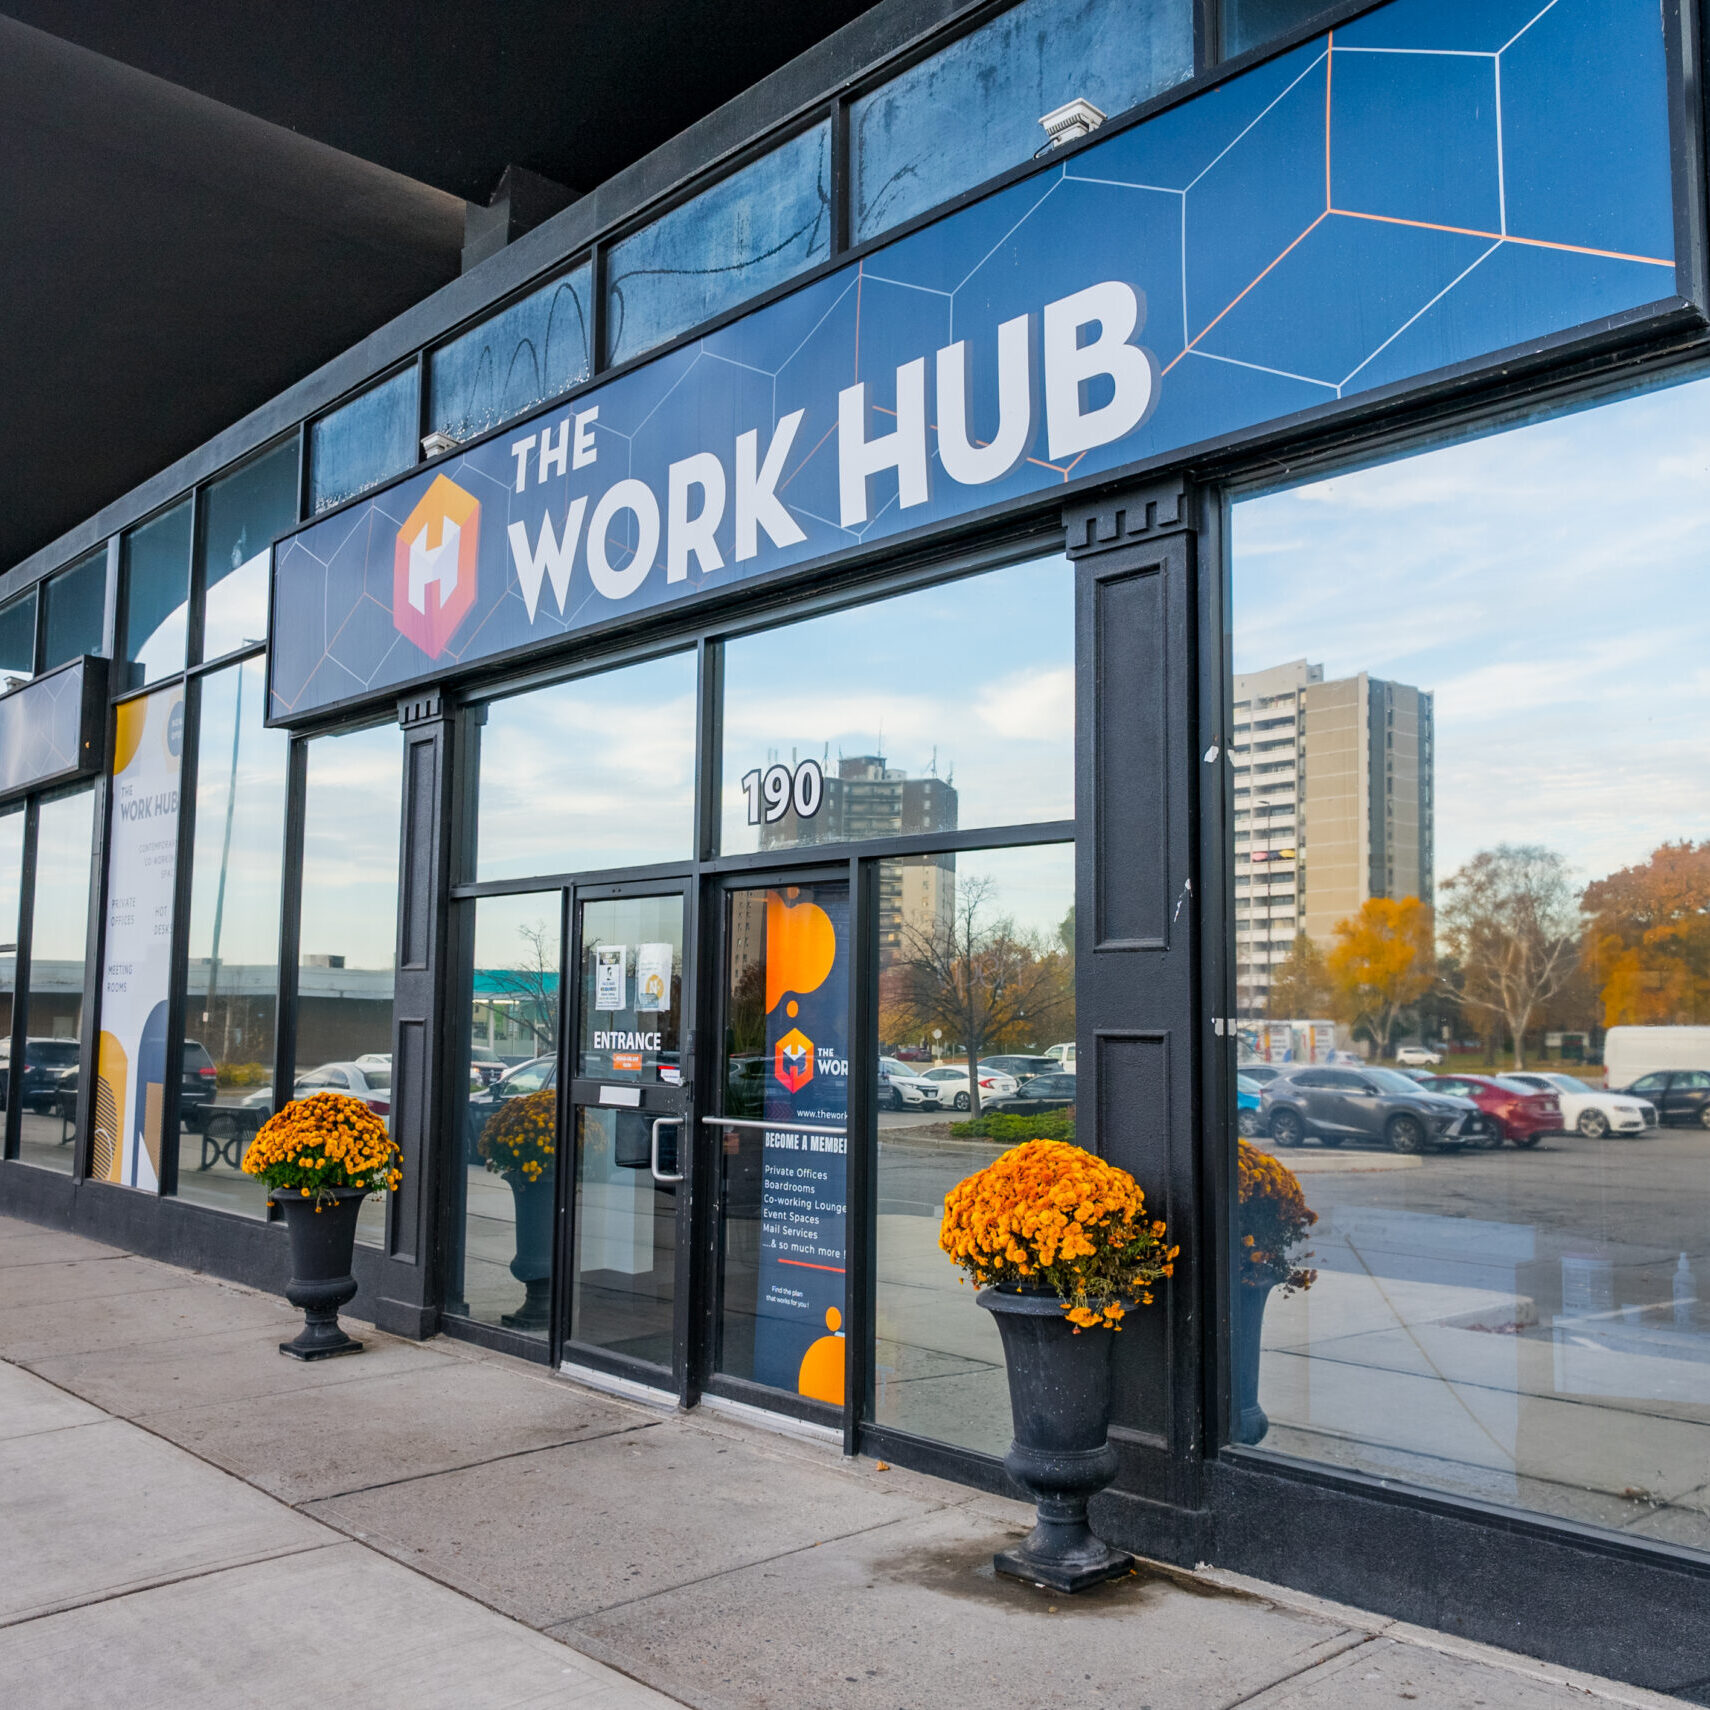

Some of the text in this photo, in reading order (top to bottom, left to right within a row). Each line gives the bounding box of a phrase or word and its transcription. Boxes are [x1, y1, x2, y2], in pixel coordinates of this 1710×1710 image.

[508, 281, 1157, 625] WORK HUB
[511, 405, 600, 494] THE
[121, 784, 133, 797] THE
[741, 759, 824, 826] 190
[120, 791, 179, 821] WORK HUB
[111, 897, 136, 910] PRIVATE
[154, 905, 168, 917] HOT
[110, 914, 135, 927] OFFICES
[107, 964, 133, 976] MEETING
[106, 982, 128, 993] ROOMS
[593, 1031, 662, 1051] ENTRANCE
[817, 1047, 834, 1057] THE
[765, 1131, 799, 1150] BECOME
[801, 1134, 808, 1151] A
[764, 1164, 828, 1181] Private Offices
[764, 1179, 815, 1195] Boardrooms
[763, 1193, 847, 1215] Co-working Lounge
[763, 1208, 820, 1226] Event Spaces
[762, 1223, 818, 1240] Mail Services
[778, 1241, 789, 1250] so
[790, 1241, 815, 1255] much
[817, 1246, 841, 1259] more
[771, 1285, 803, 1298] Find the plan
[776, 1297, 790, 1305] works
